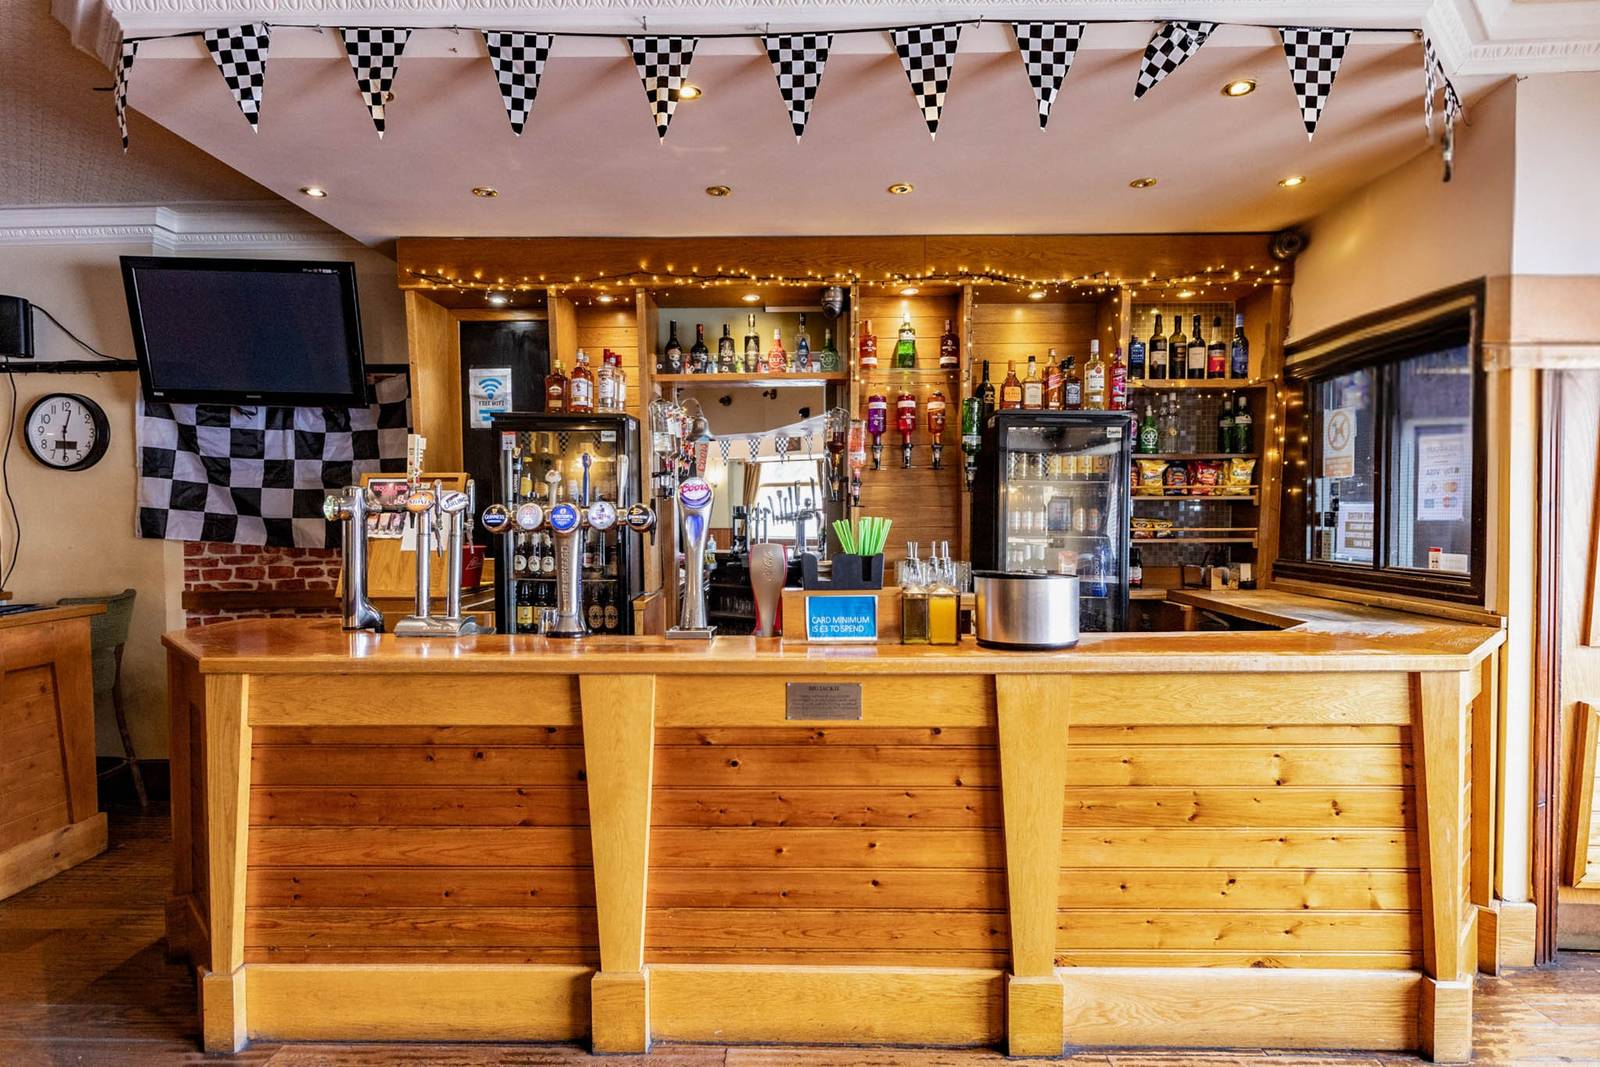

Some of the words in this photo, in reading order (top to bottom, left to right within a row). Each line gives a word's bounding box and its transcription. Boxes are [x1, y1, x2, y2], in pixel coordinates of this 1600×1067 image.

[51, 405, 57, 415] 11
[62, 402, 71, 412] 12
[41, 413, 51, 424] 10
[84, 413, 91, 425] 2
[37, 425, 45, 436] 9
[89, 427, 95, 439] 3
[41, 439, 48, 449] 8
[84, 441, 91, 450] 4
[50, 448, 56, 459] 7
[76, 449, 82, 460] 5
[680, 482, 710, 494] Coors
[811, 616, 831, 624] CARD
[832, 616, 870, 624] MINIMUM
[811, 624, 819, 632] IS
[830, 624, 840, 632] TO
[840, 624, 865, 632] SPEND
